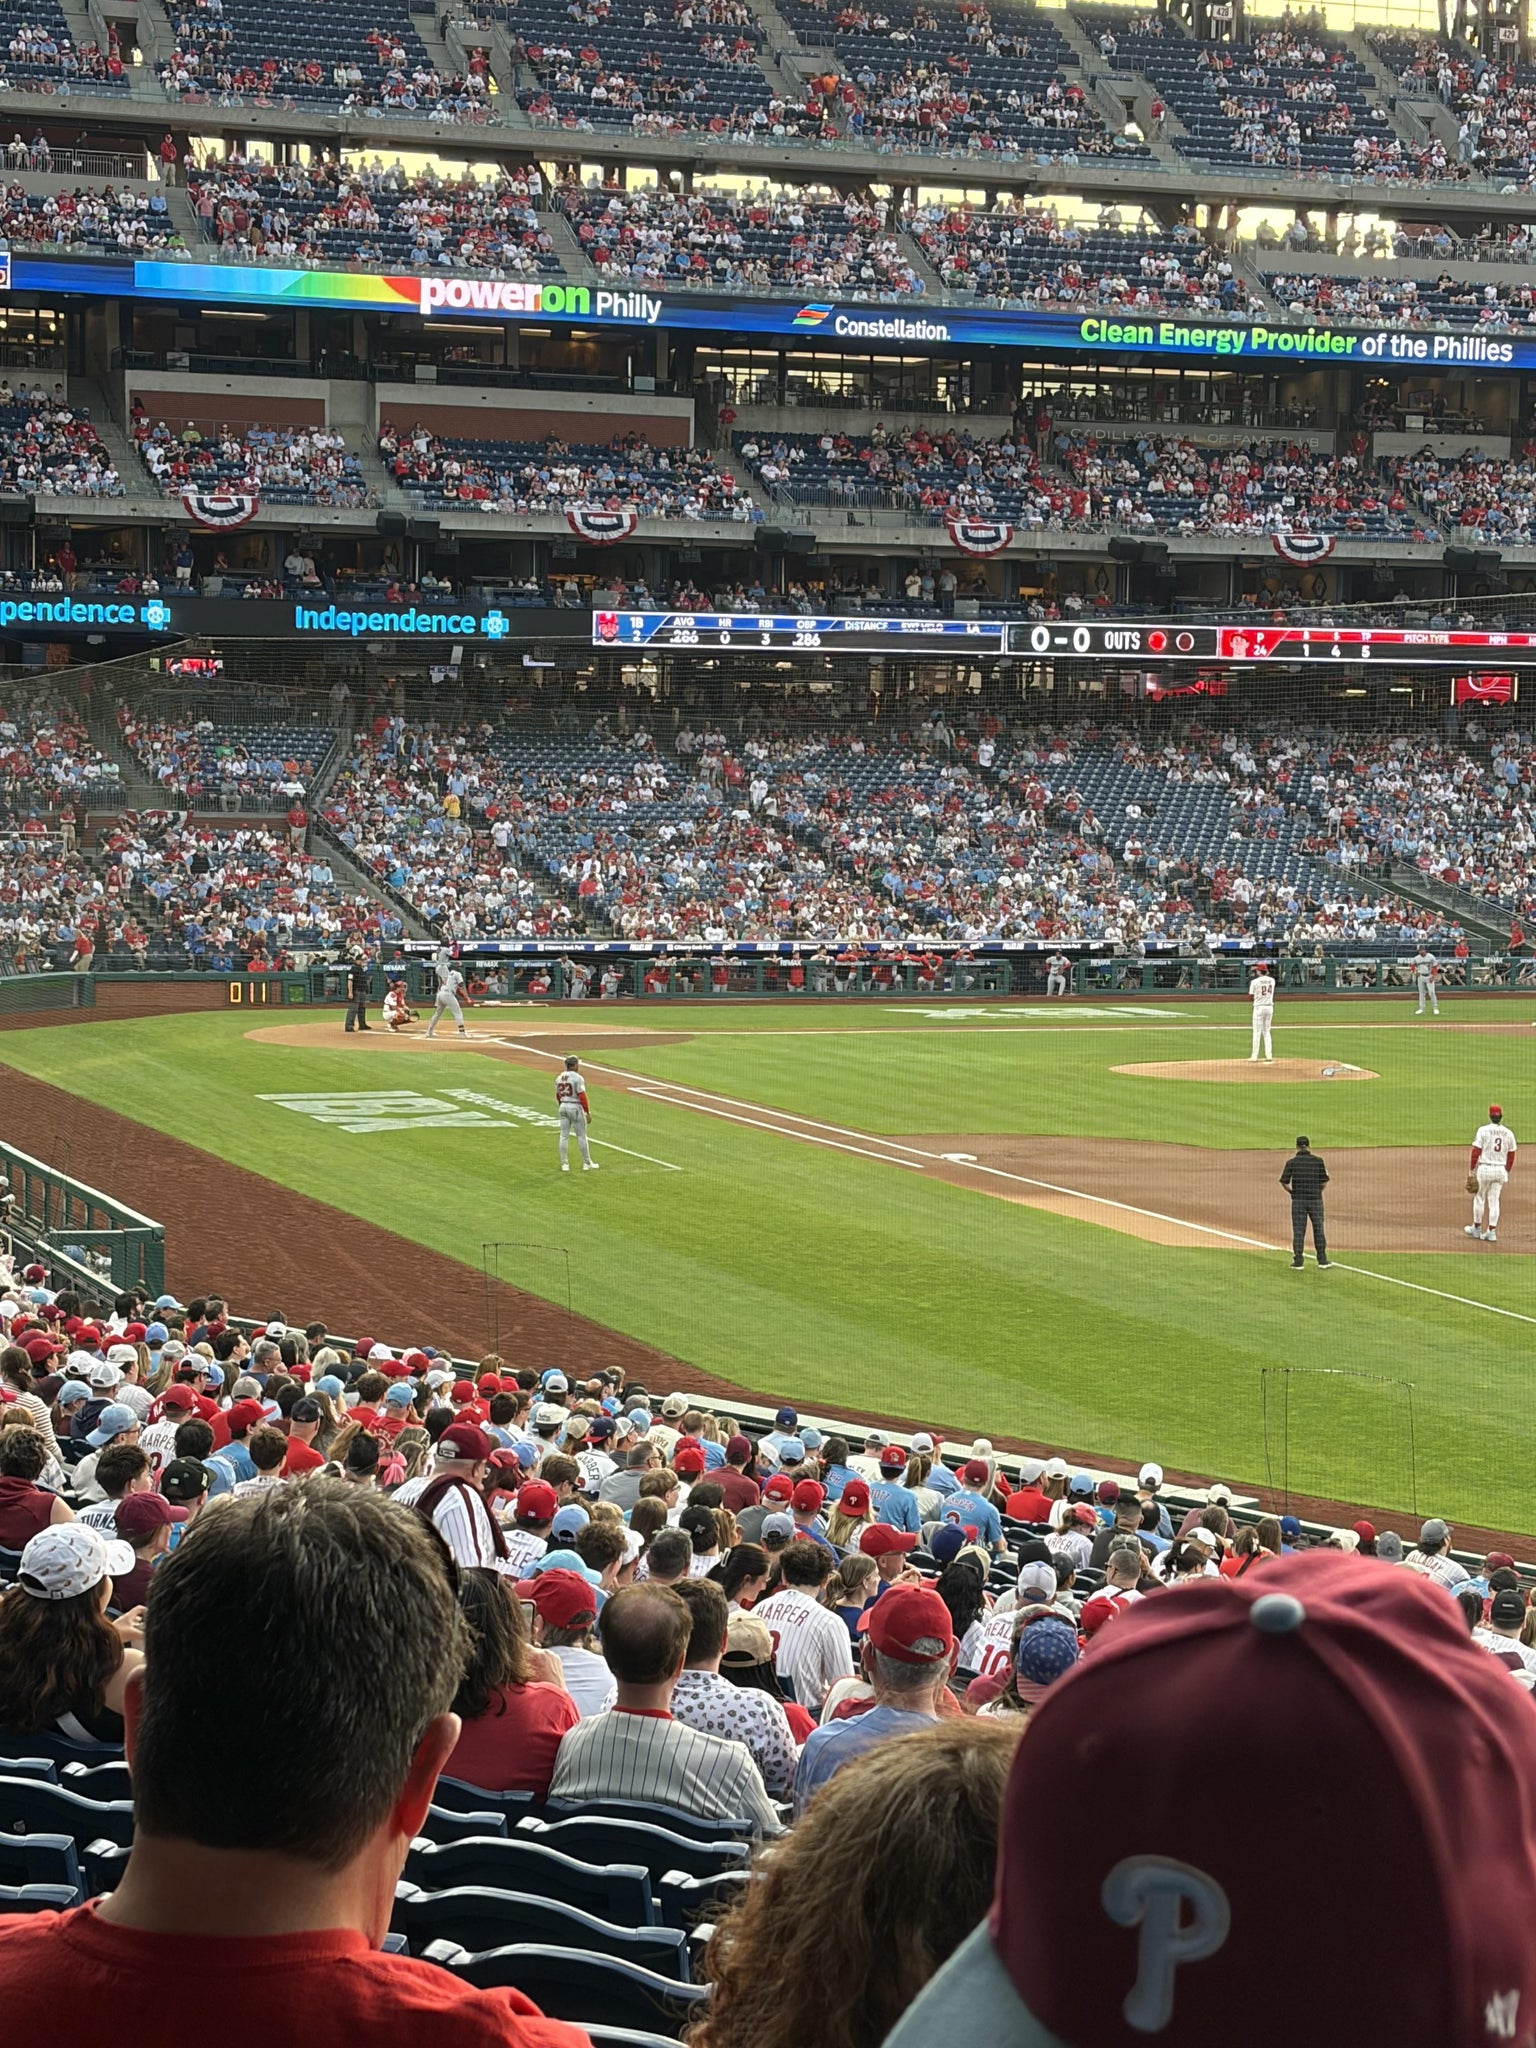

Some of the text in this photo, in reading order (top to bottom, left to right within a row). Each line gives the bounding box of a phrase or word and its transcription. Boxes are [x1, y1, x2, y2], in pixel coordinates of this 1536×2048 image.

[596, 291, 662, 323] Philly
[1080, 318, 1513, 362] Clean Energy Provider of the Phillies
[295, 604, 476, 636] Independence
[630, 616, 643, 628] 1B
[673, 616, 695, 627] AVG
[718, 617, 732, 628] HR
[758, 619, 774, 628] RBI
[761, 632, 771, 645] 3
[792, 632, 821, 647] .286
[1104, 630, 1141, 650] OUTS
[1303, 643, 1371, 658] 1 4 5
[1494, 1137, 1502, 1152] 3
[756, 1602, 810, 1627] HARPER
[984, 1621, 1012, 1641] REAL
[1101, 1854, 1231, 2034] P
